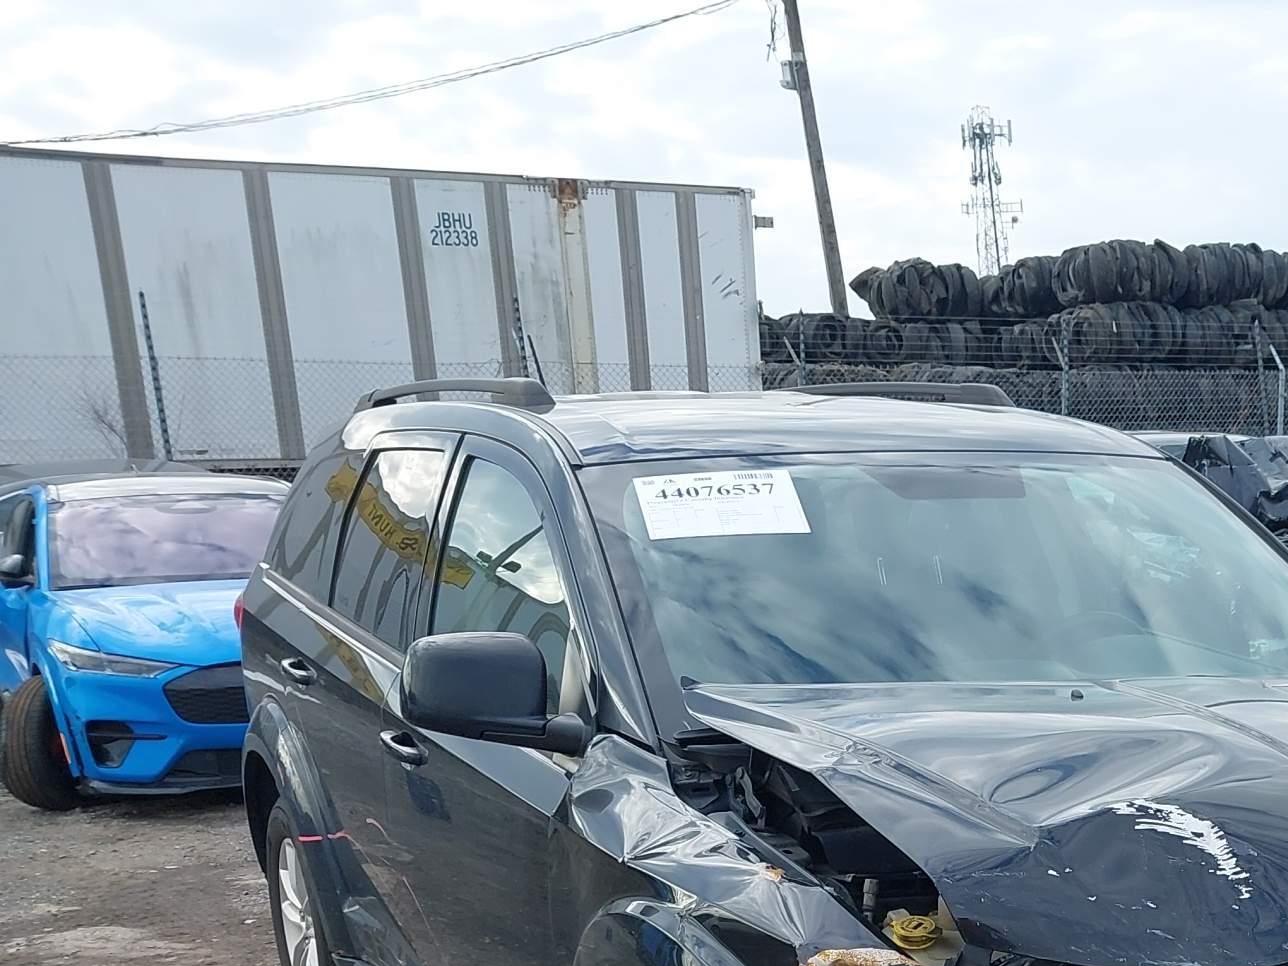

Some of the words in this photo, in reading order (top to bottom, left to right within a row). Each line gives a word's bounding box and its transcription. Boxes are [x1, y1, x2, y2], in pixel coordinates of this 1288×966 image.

[434, 212, 472, 229] JBHU
[430, 229, 478, 247] 212338
[655, 482, 774, 500] 44076537
